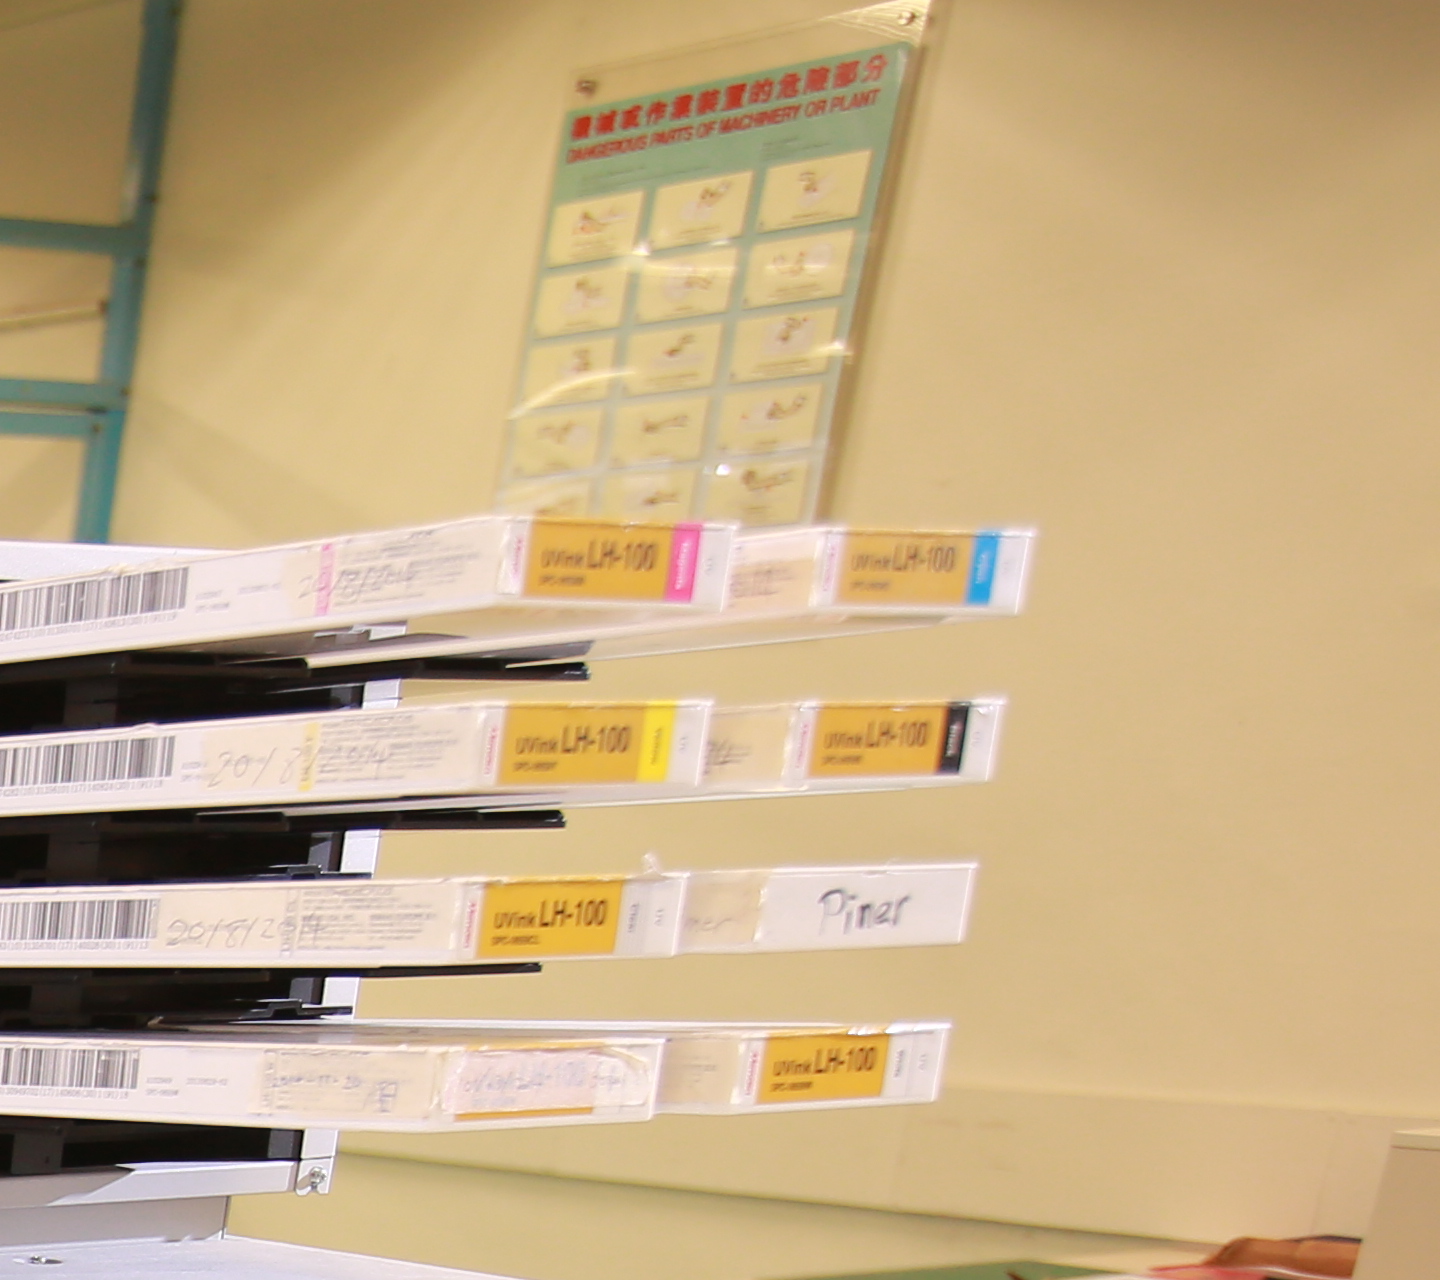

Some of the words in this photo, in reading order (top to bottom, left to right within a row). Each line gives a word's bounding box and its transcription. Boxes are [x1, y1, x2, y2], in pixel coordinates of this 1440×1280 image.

[567, 134, 648, 164] DANGEROUS
[649, 125, 694, 147] PARTS
[696, 120, 718, 139] OF
[718, 104, 801, 134] MACHINERY
[804, 99, 828, 119] OR
[830, 88, 882, 114] PLANT
[585, 538, 659, 571] LH-100
[892, 545, 957, 573] LH-100
[561, 726, 630, 755] LH-100
[864, 721, 929, 749] LH-100
[539, 899, 608, 928] LH-100
[813, 1046, 877, 1074] LH-100
